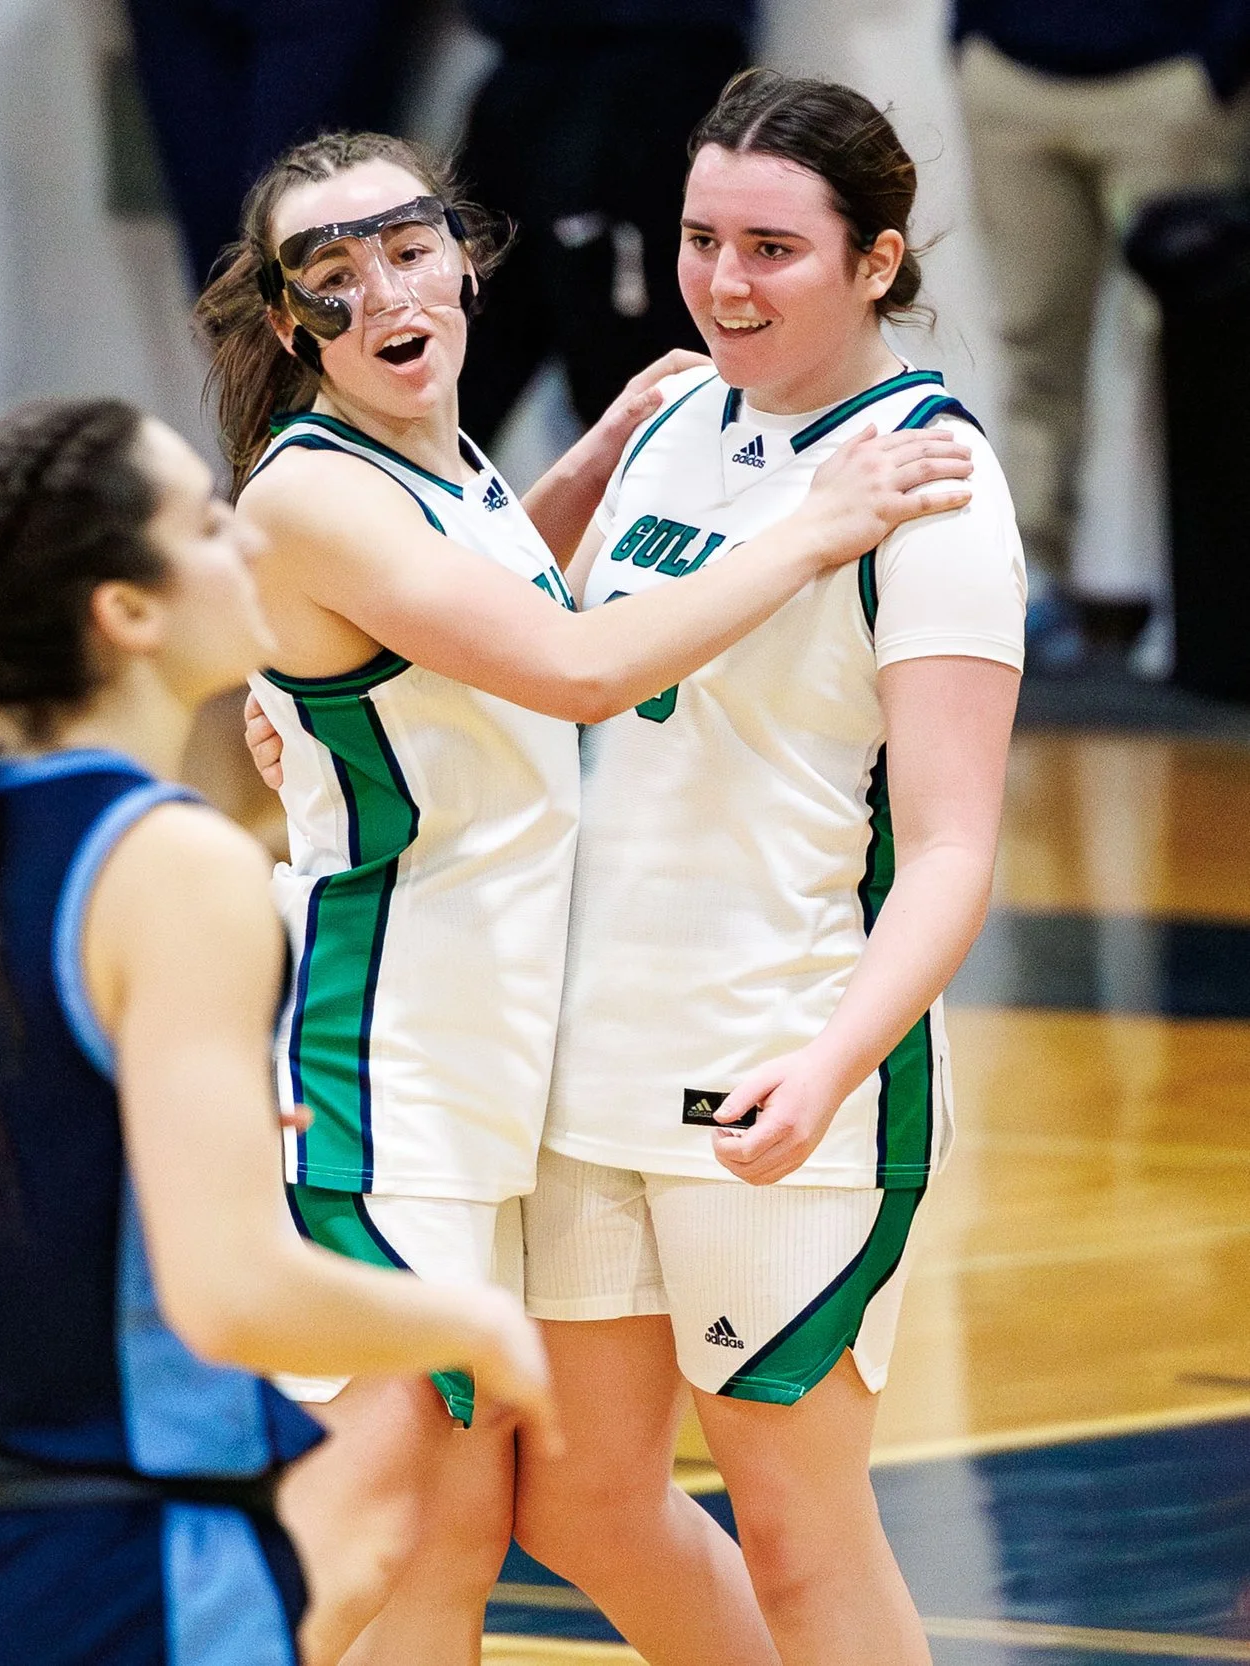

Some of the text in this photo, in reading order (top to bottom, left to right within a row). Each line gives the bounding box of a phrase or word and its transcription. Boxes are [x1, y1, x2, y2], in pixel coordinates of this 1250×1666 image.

[732, 453, 766, 469] adidas
[611, 514, 746, 577] GULL
[704, 1330, 745, 1349] adidas
